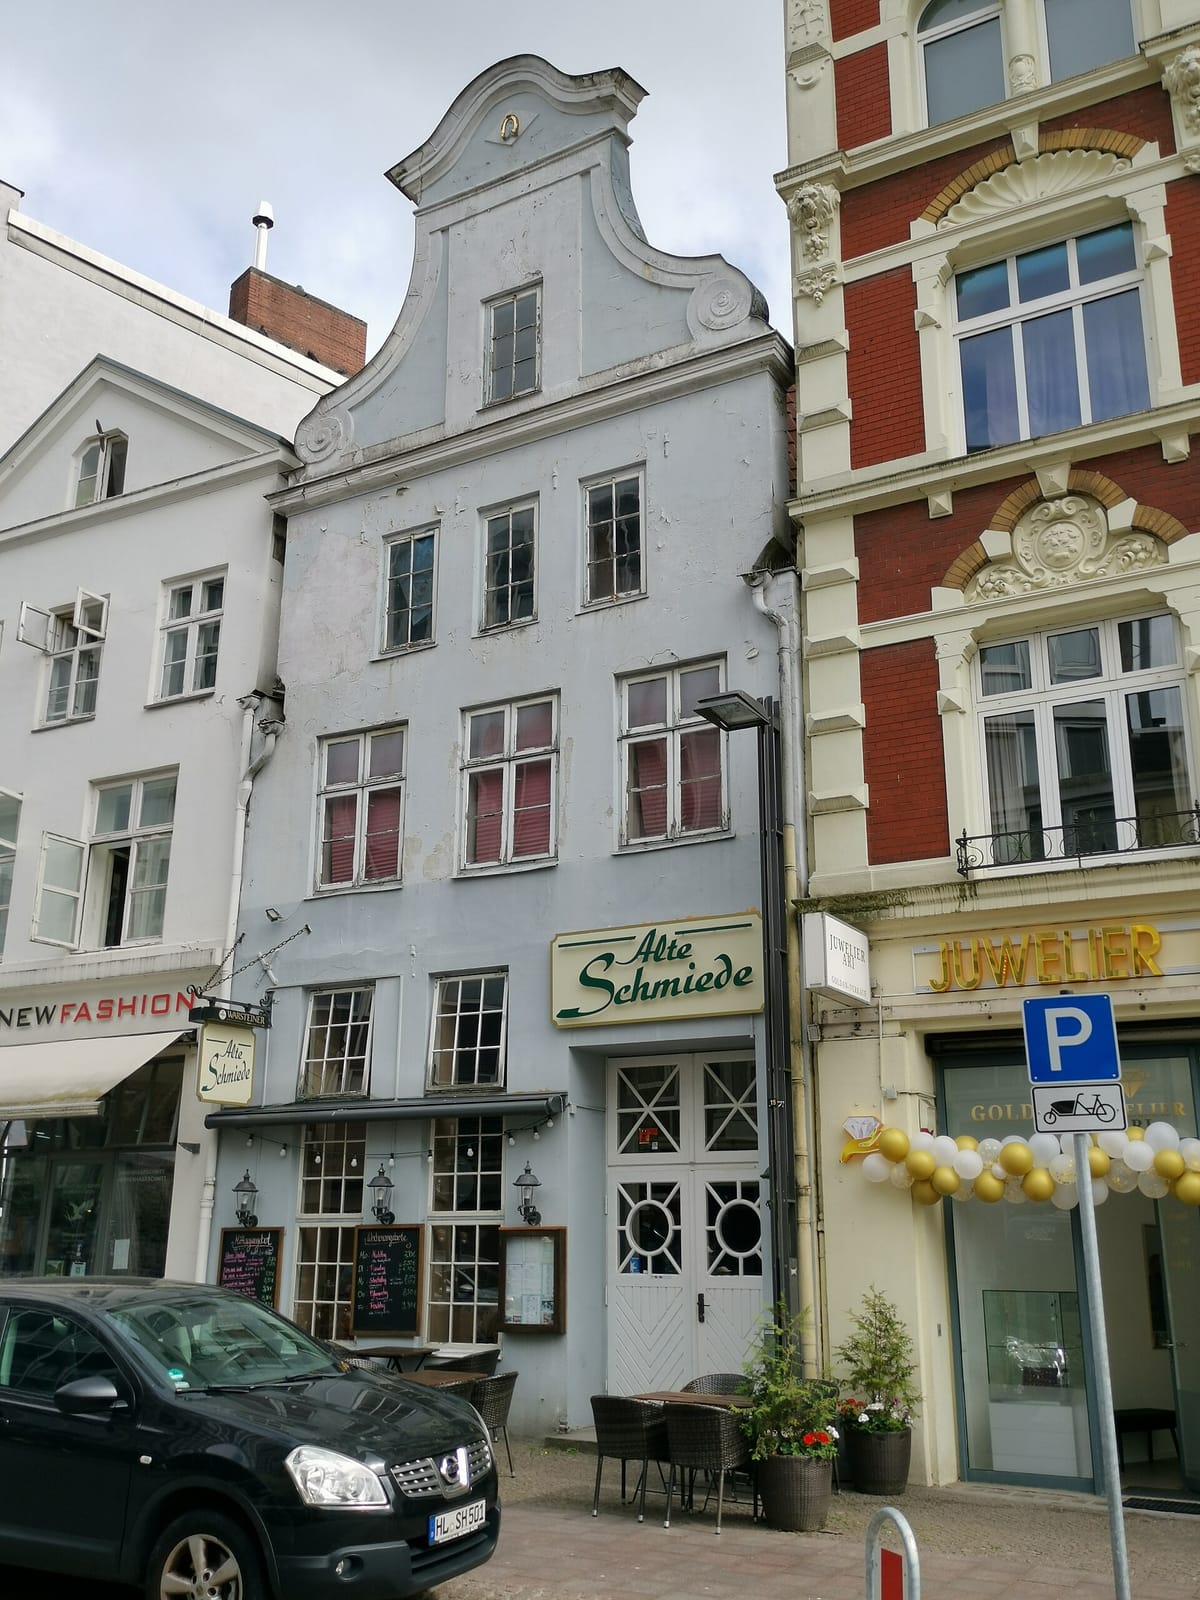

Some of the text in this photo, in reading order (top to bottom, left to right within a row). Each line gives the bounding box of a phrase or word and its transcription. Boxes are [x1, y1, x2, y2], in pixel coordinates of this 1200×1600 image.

[616, 928, 692, 965] Alte
[829, 934, 866, 964] JUWELIER
[929, 924, 1163, 992] JUWELIER
[556, 953, 754, 1018] Schmiede
[227, 1010, 265, 1025] WARSTEINER
[220, 1039, 243, 1060] Alte
[1044, 1007, 1092, 1072] P
[201, 1052, 250, 1092] Schmiede
[436, 1517, 449, 1536] HL
